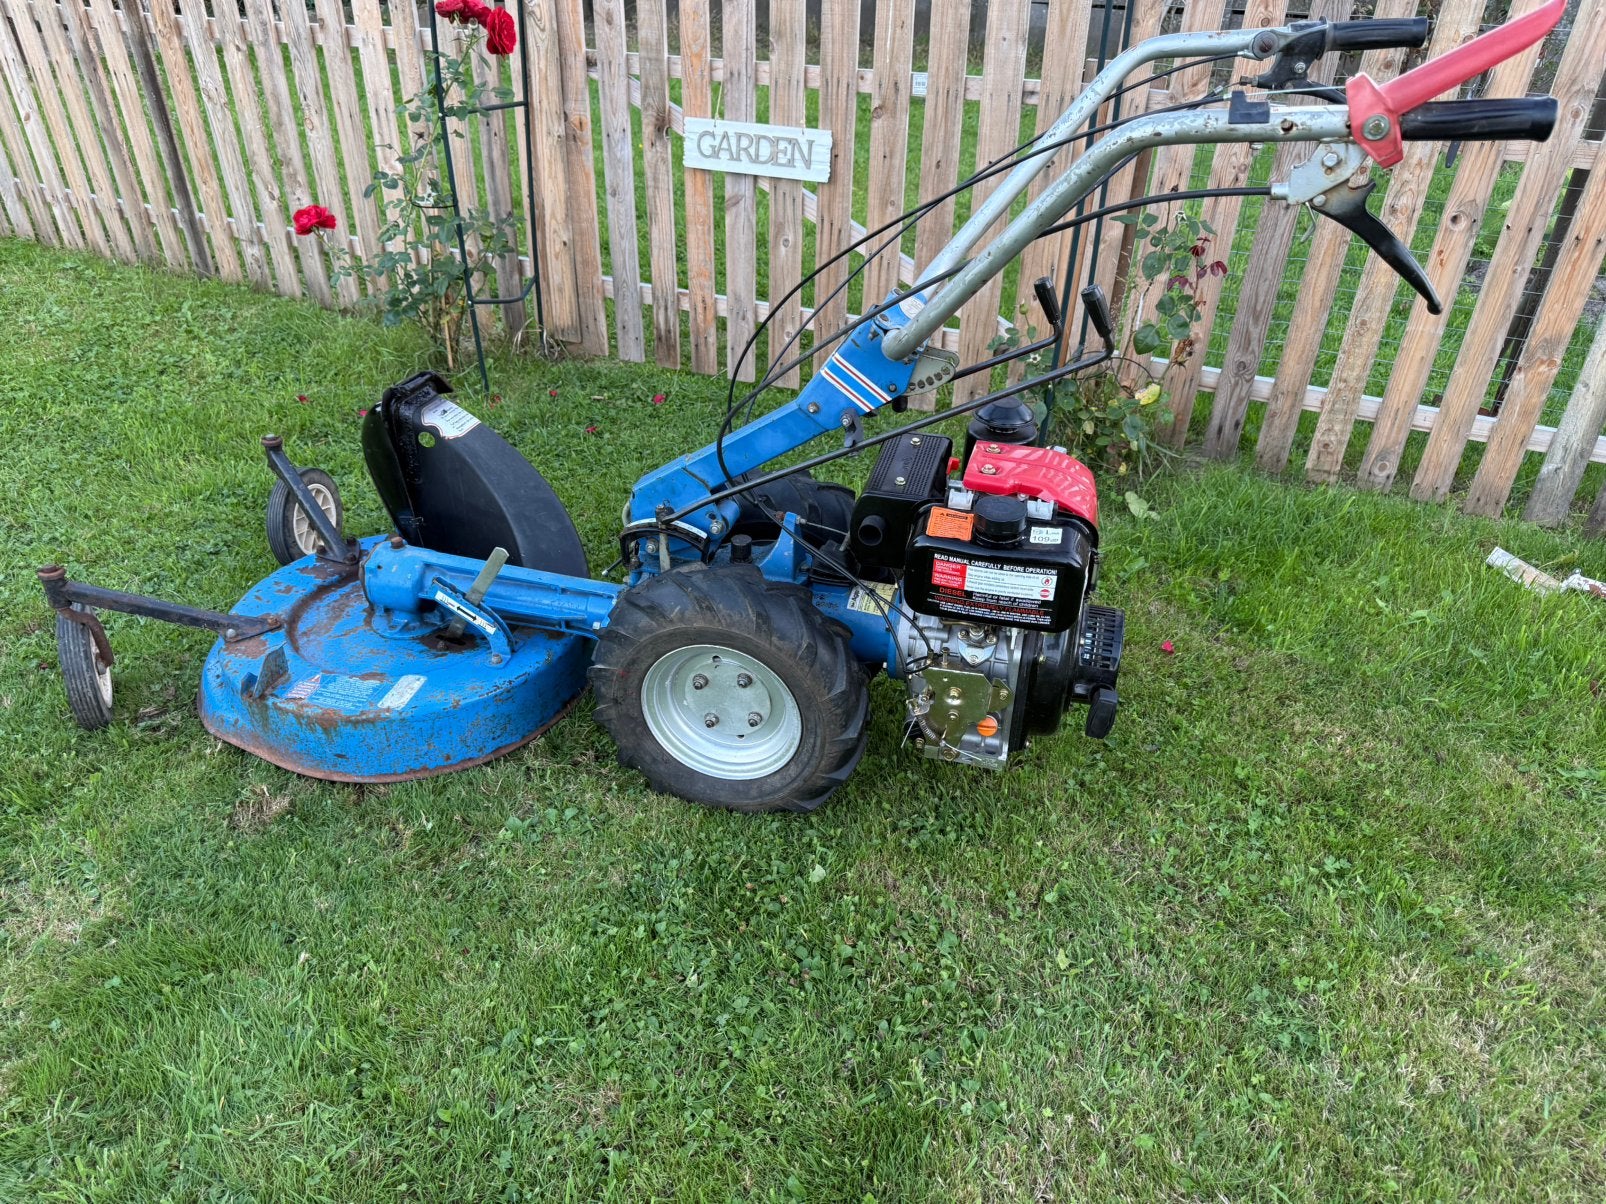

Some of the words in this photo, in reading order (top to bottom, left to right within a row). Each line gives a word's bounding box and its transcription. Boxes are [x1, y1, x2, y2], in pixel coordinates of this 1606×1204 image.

[697, 130, 815, 170] GARDEN
[949, 556, 970, 564] MANUAL
[971, 560, 1001, 569] CAREFULLY
[939, 587, 966, 597] DIESEL
[966, 601, 1004, 610] EXTREMELY
